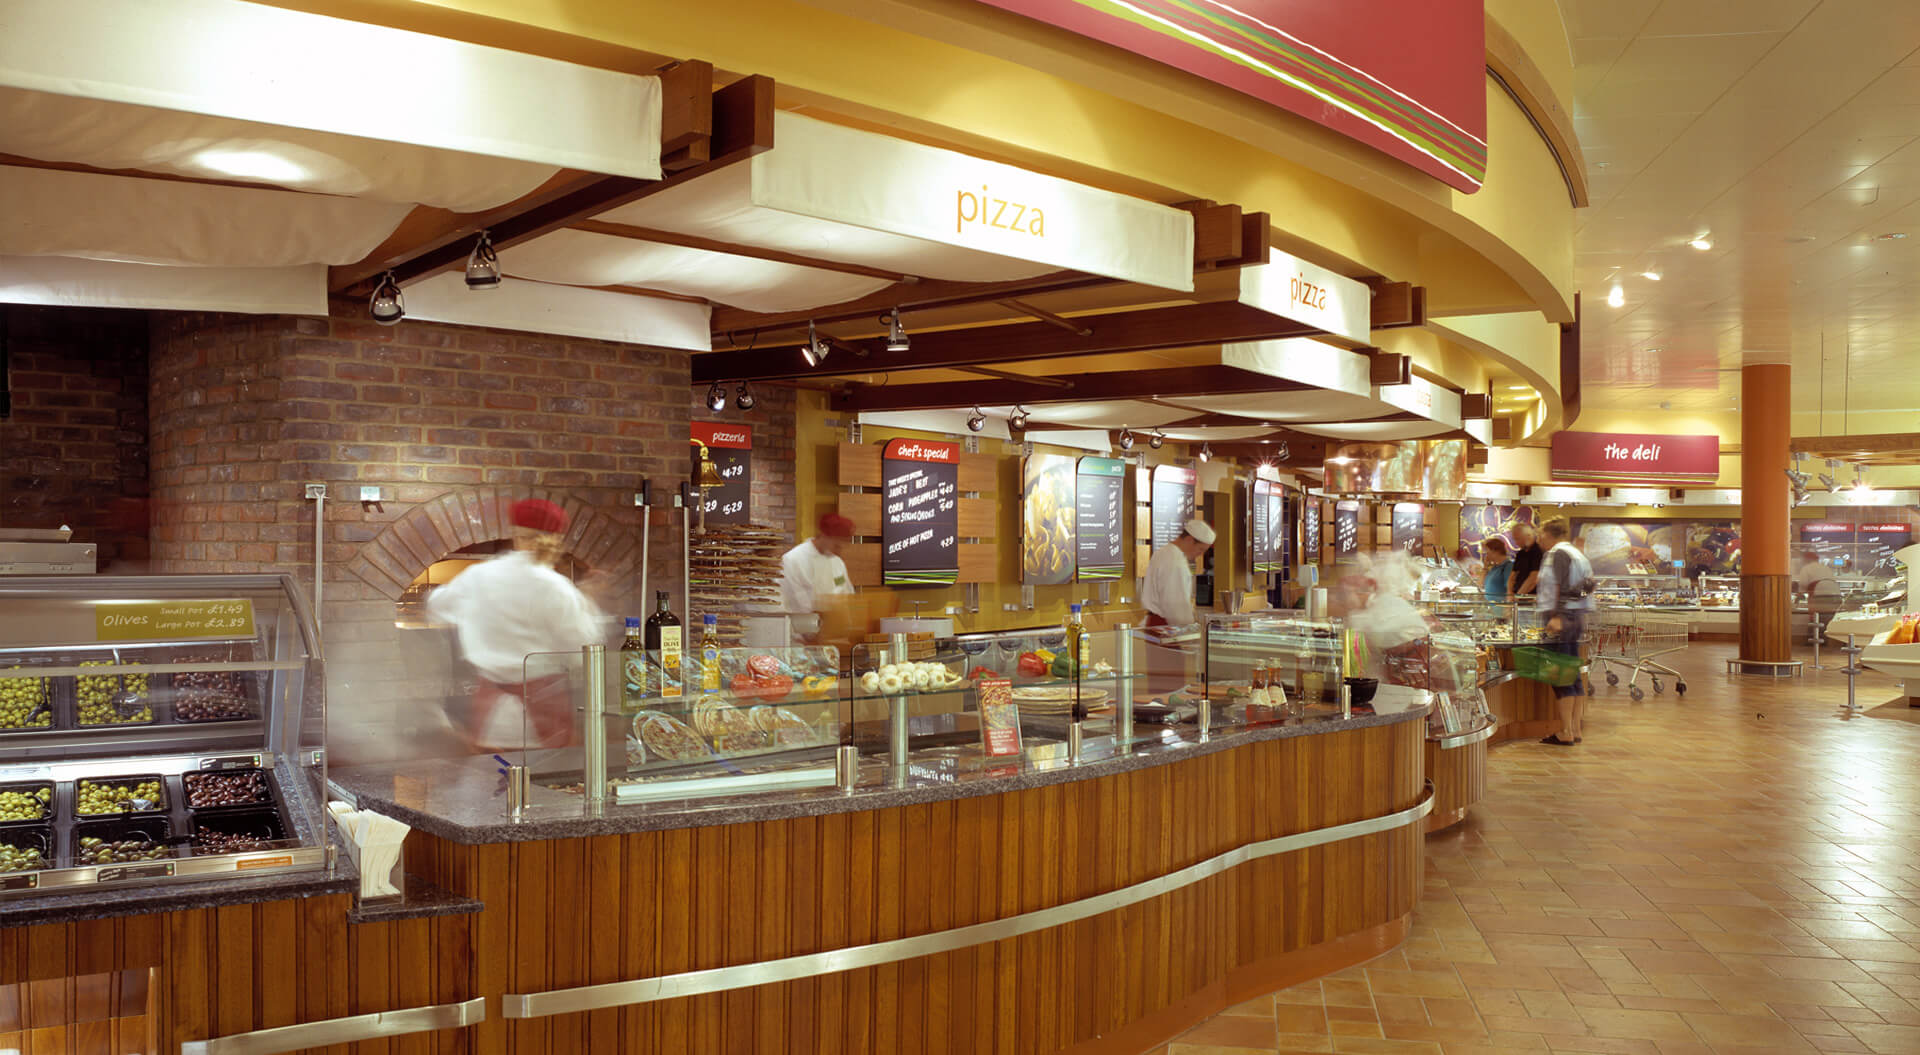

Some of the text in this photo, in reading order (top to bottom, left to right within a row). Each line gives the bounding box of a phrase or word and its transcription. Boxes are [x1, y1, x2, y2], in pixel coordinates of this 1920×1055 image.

[957, 184, 1044, 237] pizza
[1290, 271, 1327, 311] pizza
[712, 432, 745, 443] pizzeria
[898, 443, 949, 461] chef's special
[1604, 442, 1661, 461] the deli
[103, 614, 148, 626] Olives
